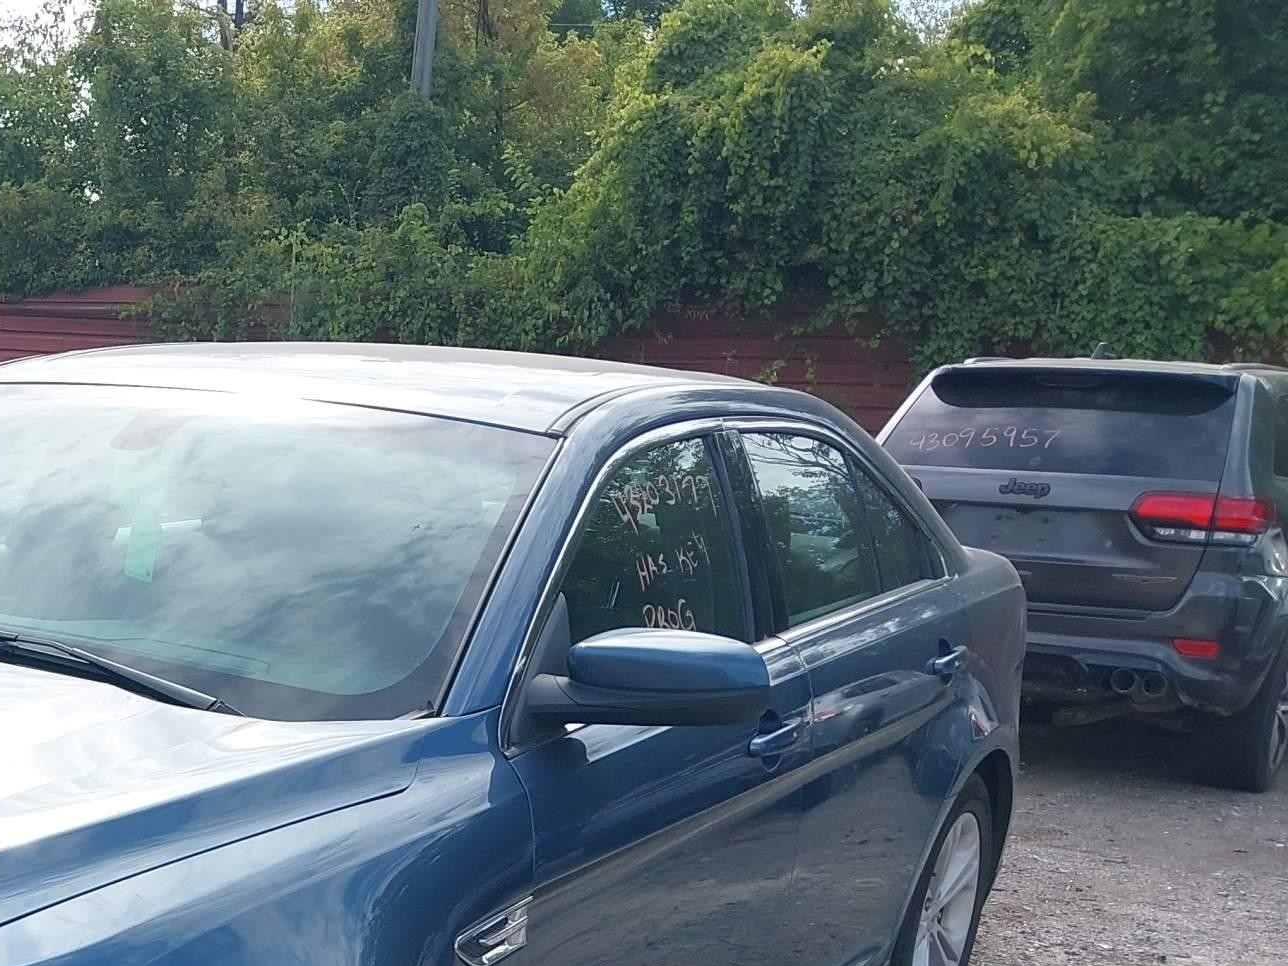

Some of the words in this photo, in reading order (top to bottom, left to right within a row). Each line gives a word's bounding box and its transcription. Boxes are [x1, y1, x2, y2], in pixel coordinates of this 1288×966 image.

[910, 426, 1062, 451] 43095957
[998, 478, 1051, 499] Jeep
[636, 553, 669, 592] HAS
